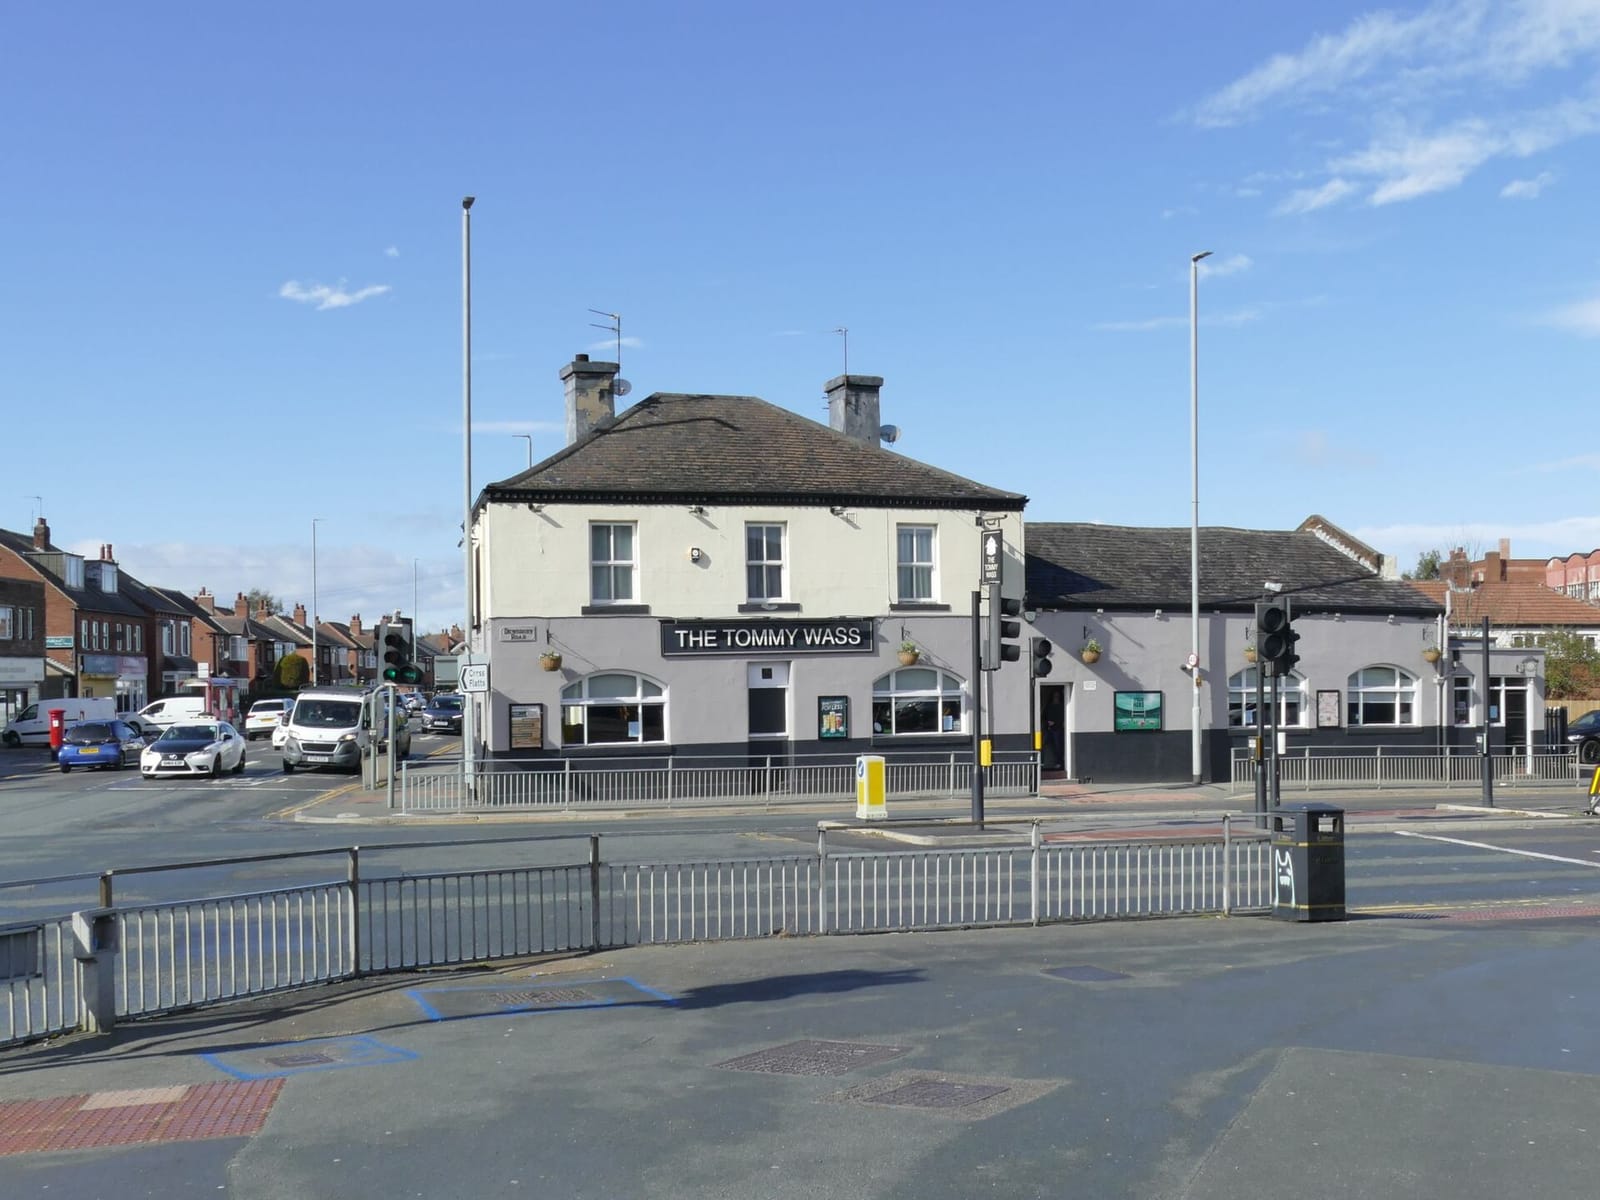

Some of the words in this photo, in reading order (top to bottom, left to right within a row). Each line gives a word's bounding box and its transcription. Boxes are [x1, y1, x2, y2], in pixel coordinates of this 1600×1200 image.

[675, 630, 717, 648] THE
[723, 628, 797, 647] TOMMY
[803, 627, 861, 645] WASS
